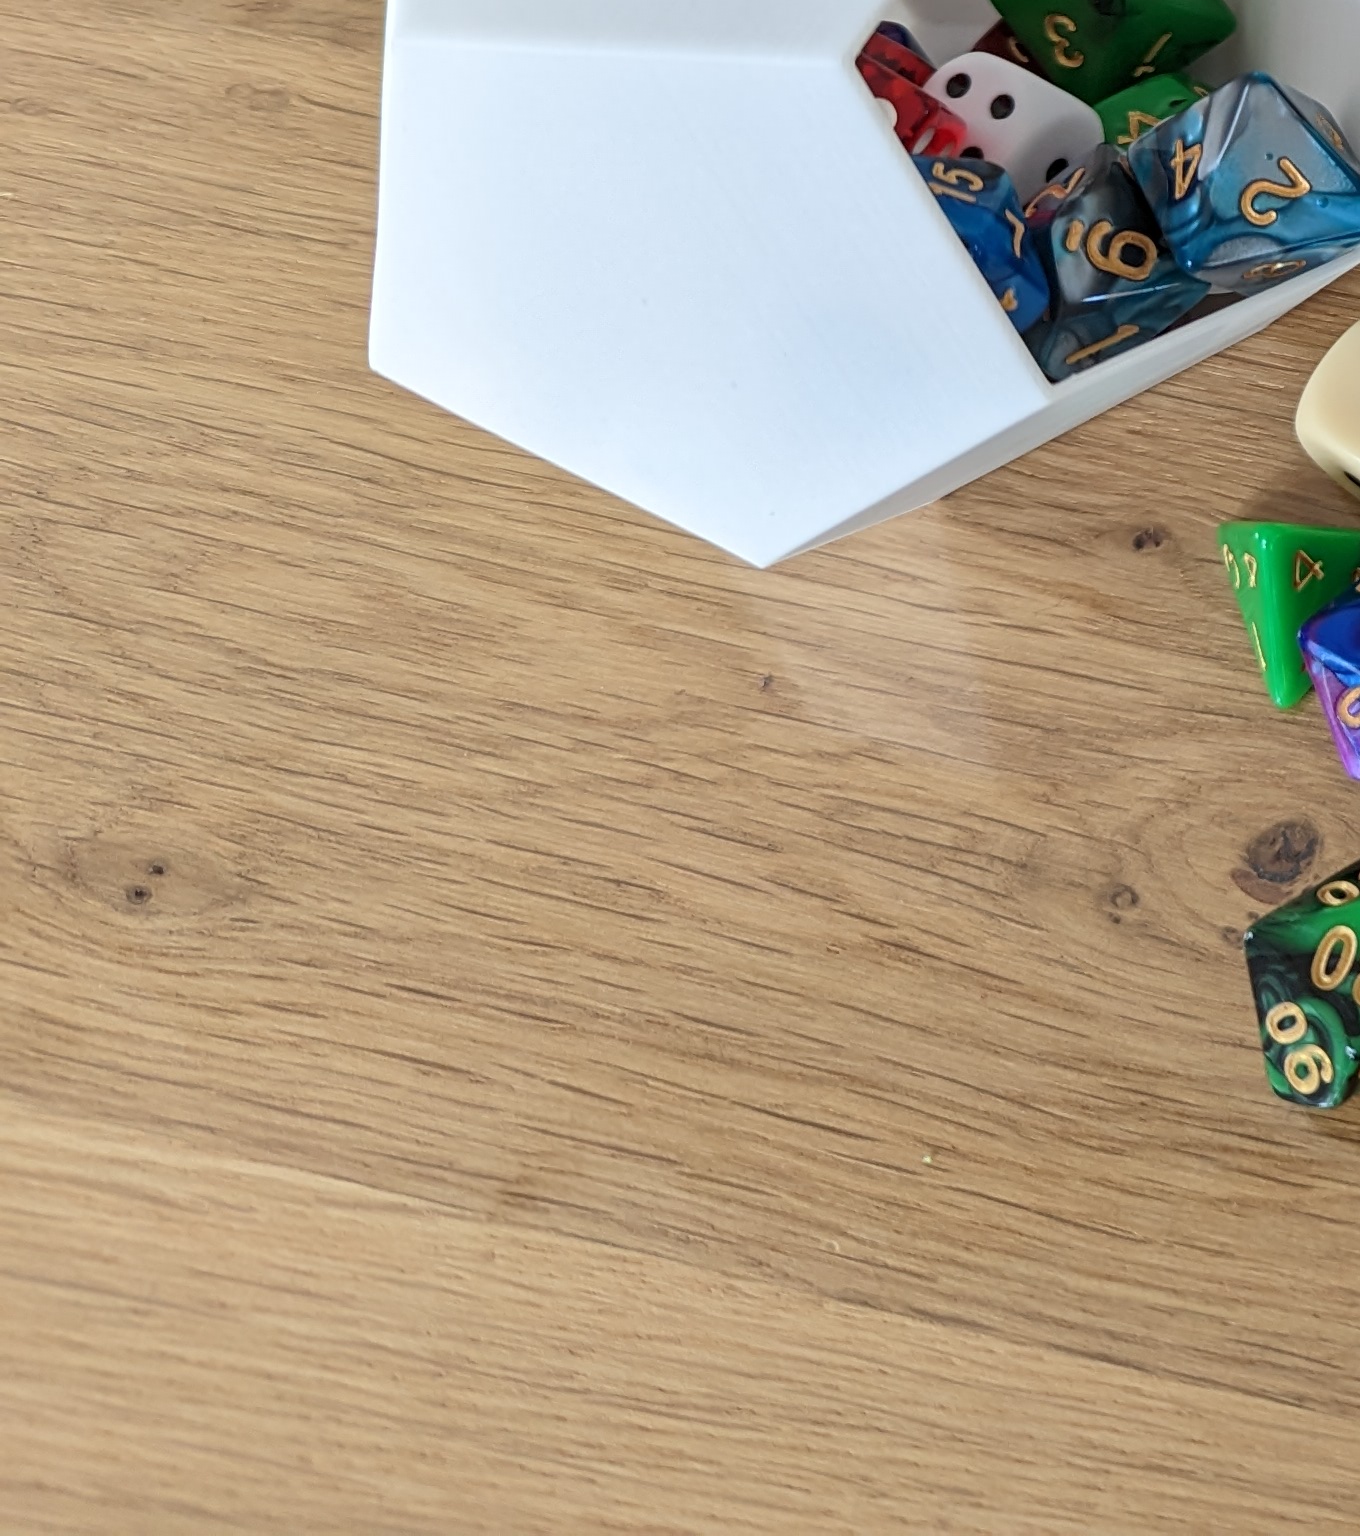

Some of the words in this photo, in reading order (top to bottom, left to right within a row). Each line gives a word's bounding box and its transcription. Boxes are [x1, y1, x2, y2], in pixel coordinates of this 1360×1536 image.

[1045, 14, 1084, 68] 3
[929, 162, 985, 203] 15
[1171, 139, 1201, 200] 4
[1240, 156, 1311, 227] 2
[1294, 549, 1325, 592] 4
